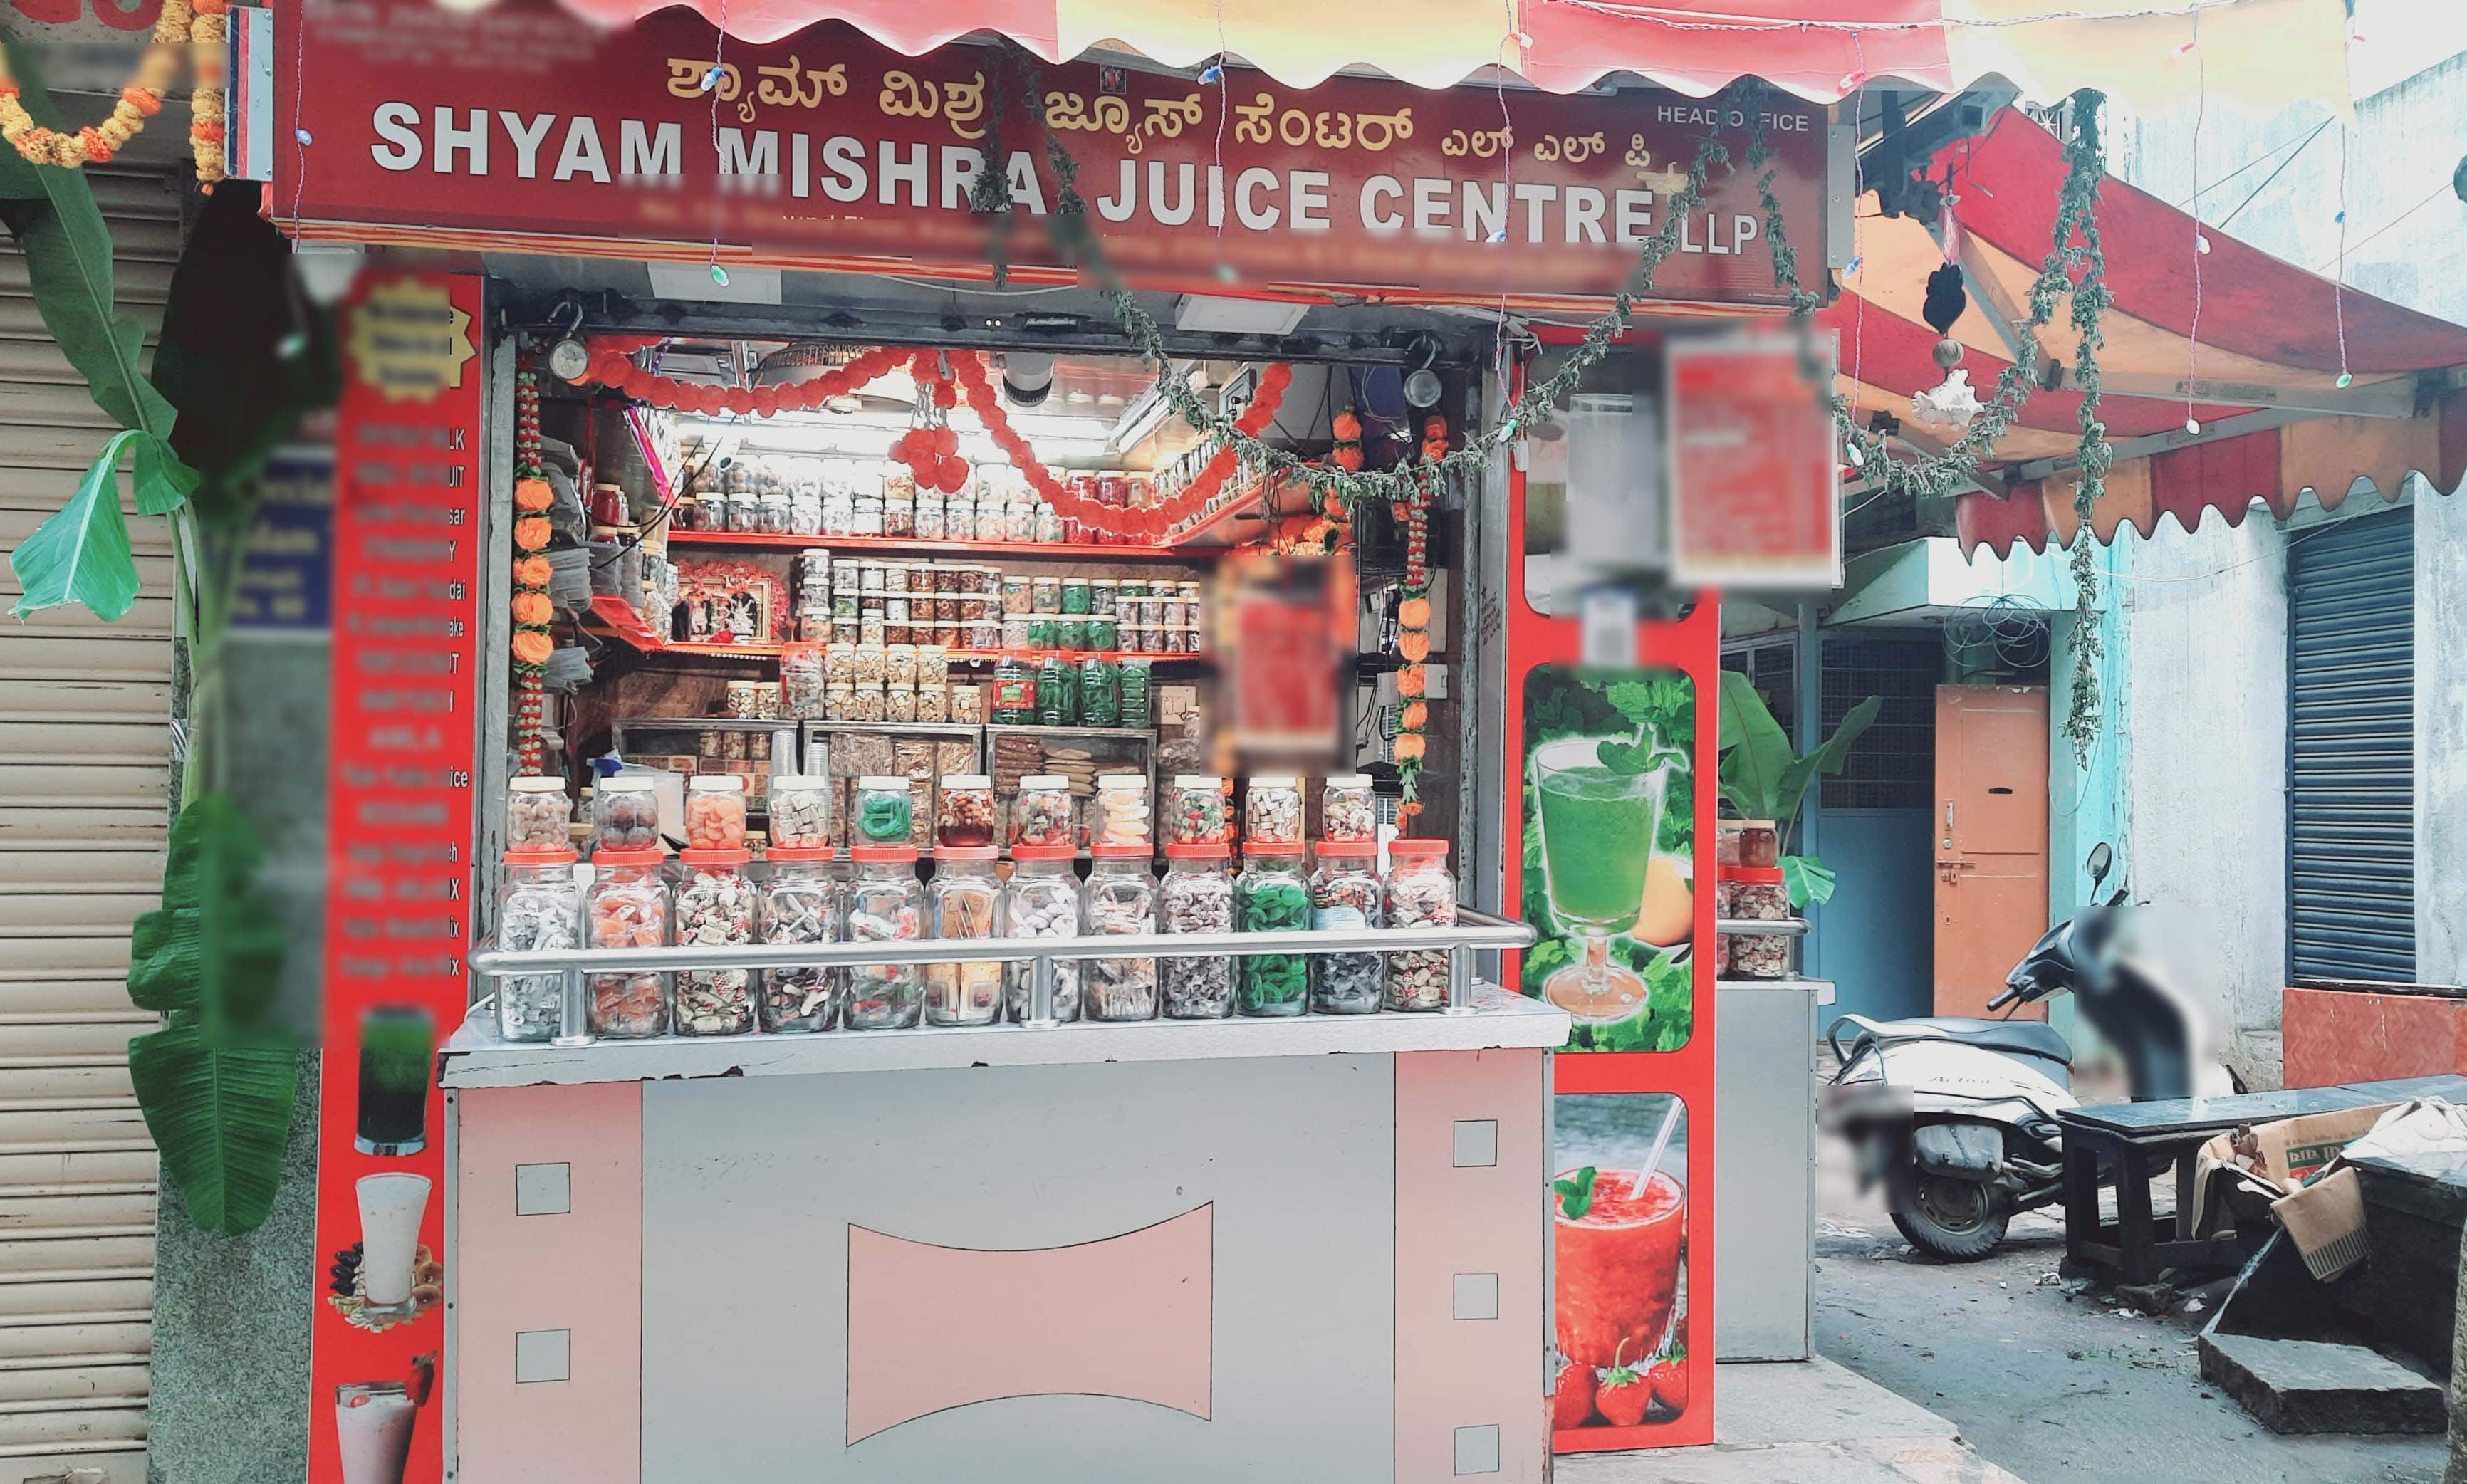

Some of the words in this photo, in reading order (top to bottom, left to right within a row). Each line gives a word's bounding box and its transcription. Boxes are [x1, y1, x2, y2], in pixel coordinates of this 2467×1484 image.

[667, 54, 848, 123] ಶ್ಯಾಮ್
[878, 70, 986, 140] ಮಿಶ್ರ
[1044, 90, 1203, 154] ಜ್ಯೂಸ್
[1234, 92, 1414, 151] ಸೆಂಟರ್
[1441, 125, 1514, 157] ಎಲ್
[1533, 131, 1605, 162] ಎಲ್
[1657, 105, 1718, 125] HEAD
[1729, 110, 1809, 132] OFICE
[370, 100, 684, 190] SHYAM
[717, 127, 1048, 214] MISHRA
[1097, 159, 1330, 234] JUICE
[1359, 174, 1652, 246] CENTRE
[1681, 213, 1758, 255] LLP
